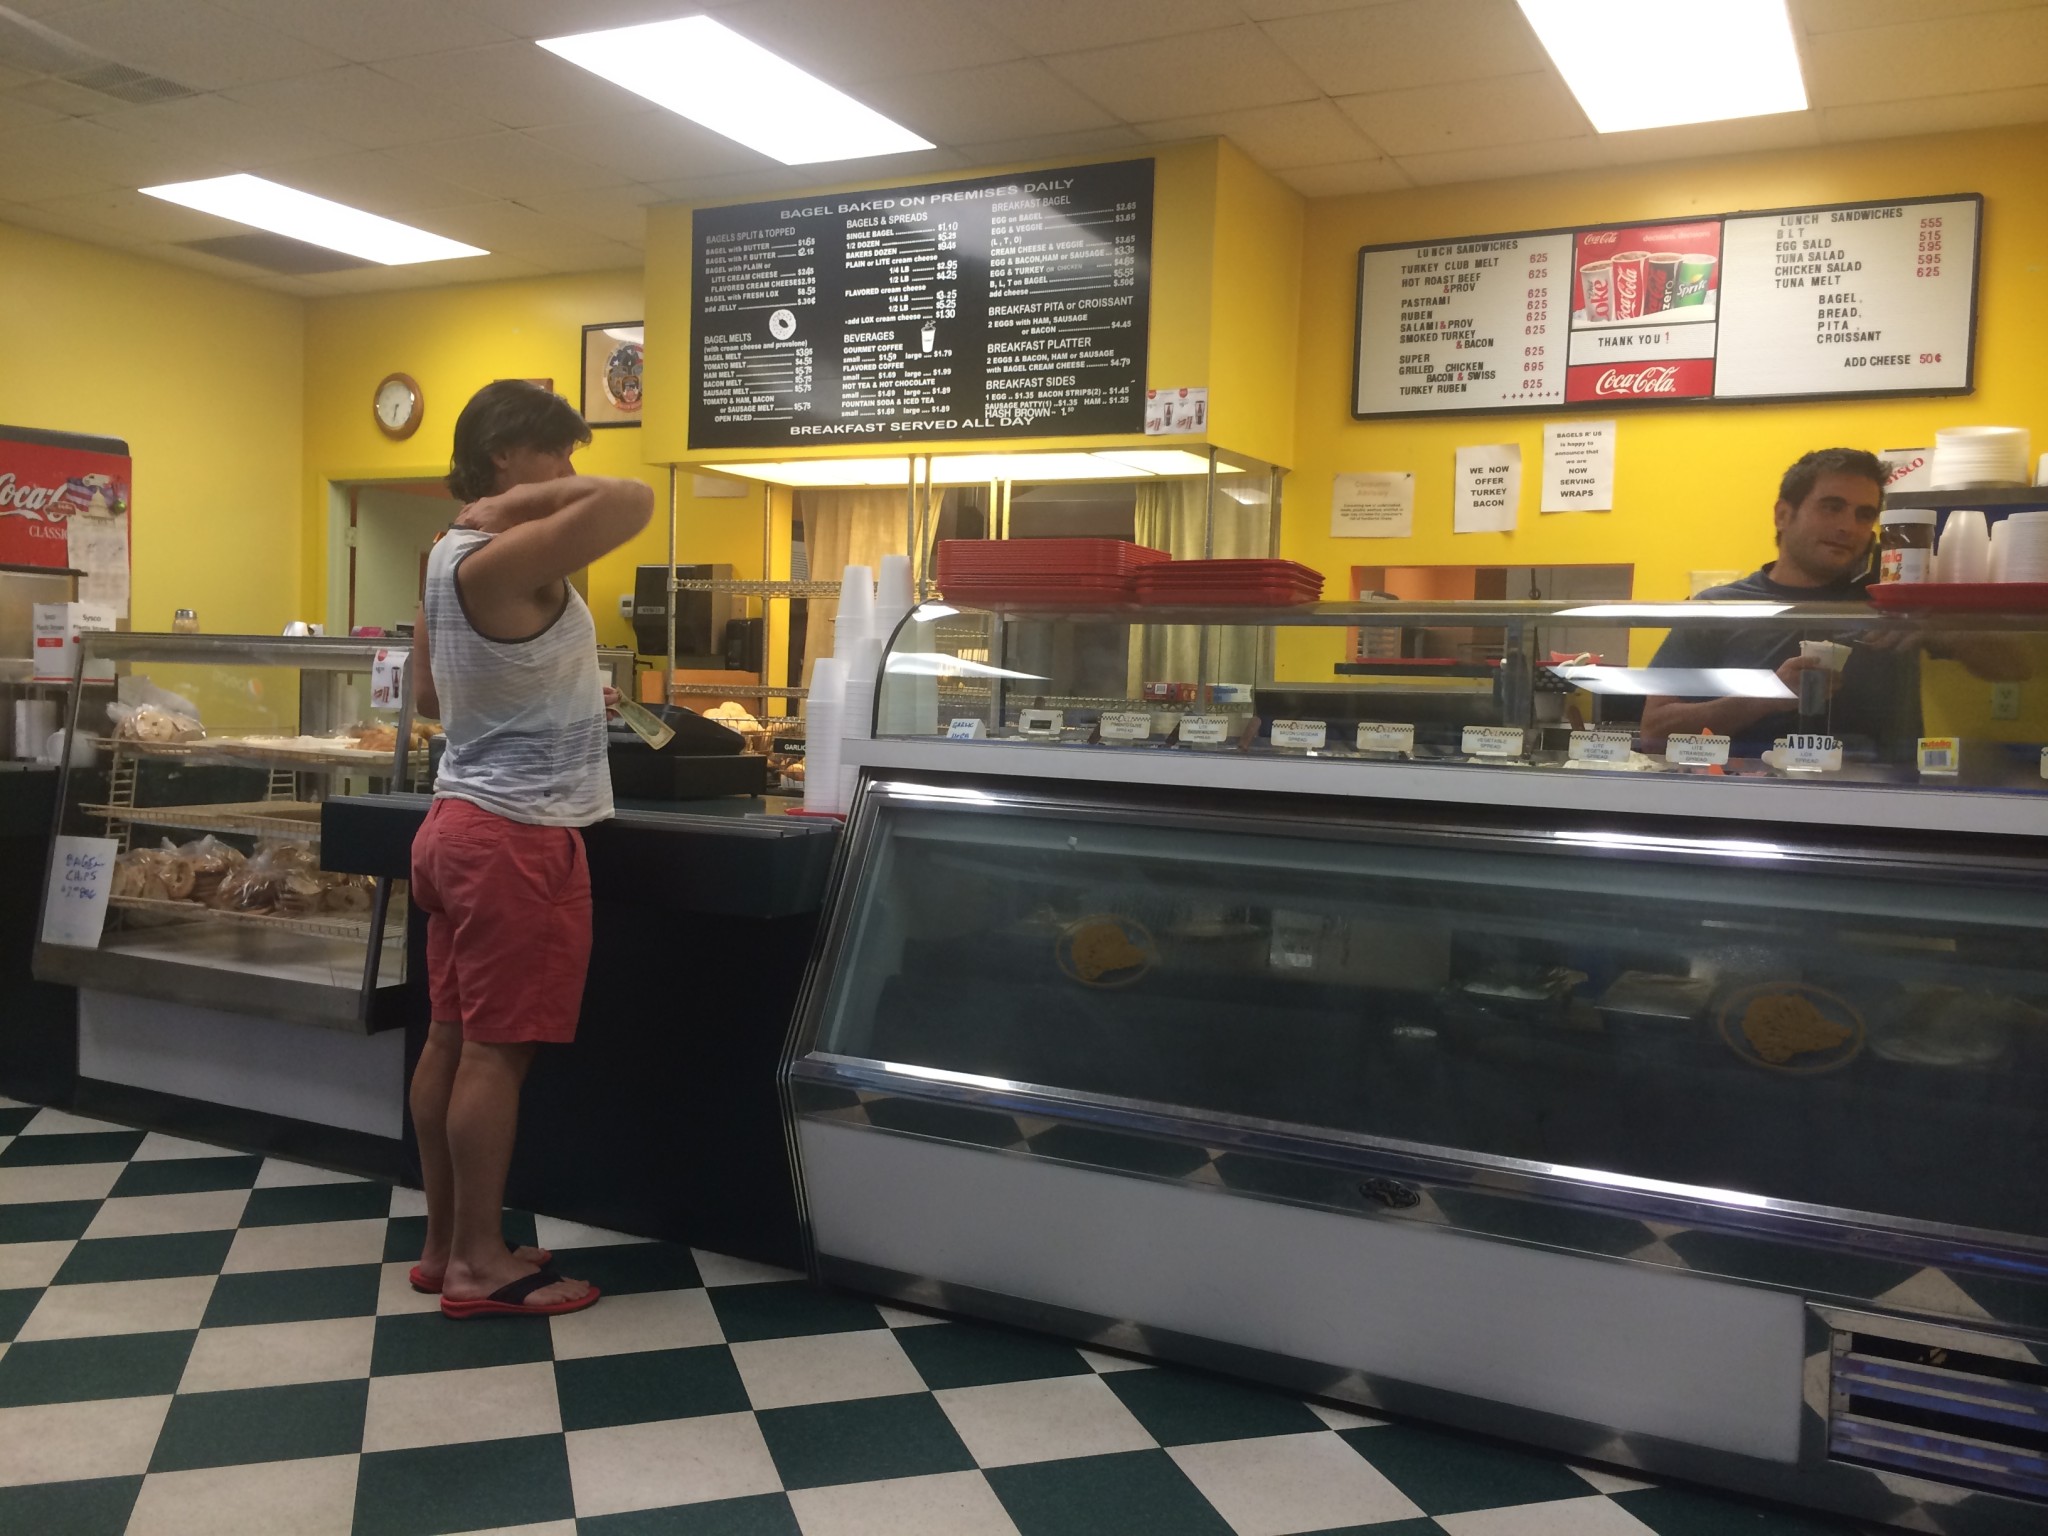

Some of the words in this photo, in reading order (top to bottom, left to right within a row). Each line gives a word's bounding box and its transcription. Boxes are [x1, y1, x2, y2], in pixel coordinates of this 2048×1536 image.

[781, 209, 833, 219] BAGEL
[838, 200, 895, 213] BAKED
[900, 196, 925, 207] ON
[931, 185, 1018, 204] PREMISES
[1024, 179, 1074, 193] DAILY
[992, 199, 1041, 213] BREAKFAST
[1043, 196, 1071, 207] BAGEL
[846, 217, 878, 228] BAGELS
[881, 217, 886, 225] &
[889, 212, 928, 224] SPREADS
[1781, 214, 1819, 226] LUNCH
[1831, 208, 1903, 222] SANDWICHES
[1920, 217, 1942, 228] 555
[706, 233, 735, 244] BAGELS
[737, 231, 757, 240] SPLIT
[765, 227, 795, 237] TOPPED
[846, 232, 870, 240] SINGLE
[872, 229, 894, 237] BAGEL
[1776, 241, 1796, 251] EGG
[1803, 239, 1831, 249] SALD
[1920, 230, 1940, 241] 515
[846, 251, 872, 259] BAKERS
[874, 248, 897, 256] DOZEN
[1418, 245, 1452, 258] LUNCH
[1457, 240, 1518, 254] SANDWICHES
[1776, 253, 1803, 264] TUNA
[1808, 250, 1844, 261] SALAD
[1919, 241, 1941, 251] 595
[1402, 263, 1438, 274] TURKEY
[1445, 260, 1469, 271] CLUB
[1475, 258, 1499, 268] MELT
[1530, 253, 1548, 263] 625
[1775, 264, 1821, 276] CHICKEN
[1827, 261, 1862, 273] SALAD
[1918, 254, 1941, 265] 595
[1402, 278, 1420, 287] HOT
[1425, 275, 1454, 285] ROAST
[1458, 273, 1481, 283] BEEF
[1529, 269, 1547, 279] 625
[1776, 278, 1804, 288] TUNA
[1811, 276, 1840, 286] MELT
[1917, 267, 1940, 277] 625
[711, 283, 744, 293] FLAVORED
[746, 281, 770, 289] CREAM
[1677, 280, 1705, 297] Sprite
[1402, 296, 1450, 308] PASTRAMI
[1528, 288, 1547, 298] 625
[1663, 280, 1674, 311] zero
[989, 303, 1042, 316] BREAKFAST
[1044, 301, 1065, 312] PITA
[1078, 296, 1134, 309] CROISSANT
[1401, 311, 1432, 321] RUBEN
[1527, 300, 1547, 310] 625
[994, 319, 1013, 327] EGGS
[1016, 317, 1031, 326] with
[1053, 314, 1088, 323] SAUSAGE
[1527, 311, 1546, 321] 625
[1031, 326, 1056, 334] BACON
[1111, 321, 1131, 329] $4.45
[1400, 333, 1438, 343] SMOKED
[1441, 330, 1475, 340] TURKEY
[1525, 325, 1545, 335] 625
[704, 335, 727, 344] BAGEL
[729, 333, 751, 342] MELTS
[844, 331, 895, 343] BEVERAGES
[987, 340, 1045, 353] BREAKFAST
[1047, 337, 1091, 349] PLATTER
[1598, 336, 1633, 347] THANK
[1639, 334, 1660, 344] YOU
[1817, 332, 1881, 343] CROISSANT
[844, 345, 876, 354] GOURMET
[878, 344, 903, 352] COFFEE
[993, 356, 1012, 364] EGGS
[1052, 353, 1068, 361] HAM
[1079, 350, 1114, 358] SAUSAGE
[1399, 354, 1429, 363] SUPER
[1525, 347, 1544, 356] 625
[843, 364, 877, 372] FLAVORED
[879, 362, 904, 370] COFFEE
[986, 366, 1001, 374] with
[1003, 365, 1027, 373] BAGEL
[1029, 363, 1054, 371] CREAM
[1056, 361, 1085, 369] CHEESE
[1399, 365, 1433, 375] GRILLED
[1446, 362, 1483, 372] CHICKEN
[1524, 362, 1544, 371] 695
[1845, 357, 1866, 367] ADD
[1870, 355, 1910, 366] CHEESE
[986, 377, 1044, 390] BREAKFAST
[1046, 376, 1075, 386] SIDES
[1427, 373, 1453, 382] BACON
[1457, 373, 1463, 381] &
[1468, 371, 1495, 380] SWISS
[1596, 366, 1680, 395] Coca-Cola
[1400, 386, 1433, 395] TURKEY
[1437, 384, 1467, 393] RUBEN
[1523, 379, 1542, 389] 625
[985, 409, 1011, 418] HASH
[1015, 408, 1050, 417] BROWN
[790, 422, 886, 435] BREAKFAST
[890, 420, 958, 431] SERVED
[962, 418, 994, 429] ALL
[1000, 417, 1034, 426] DAY
[1471, 488, 1507, 496] TURKEY
[83, 614, 101, 622] Sysco
